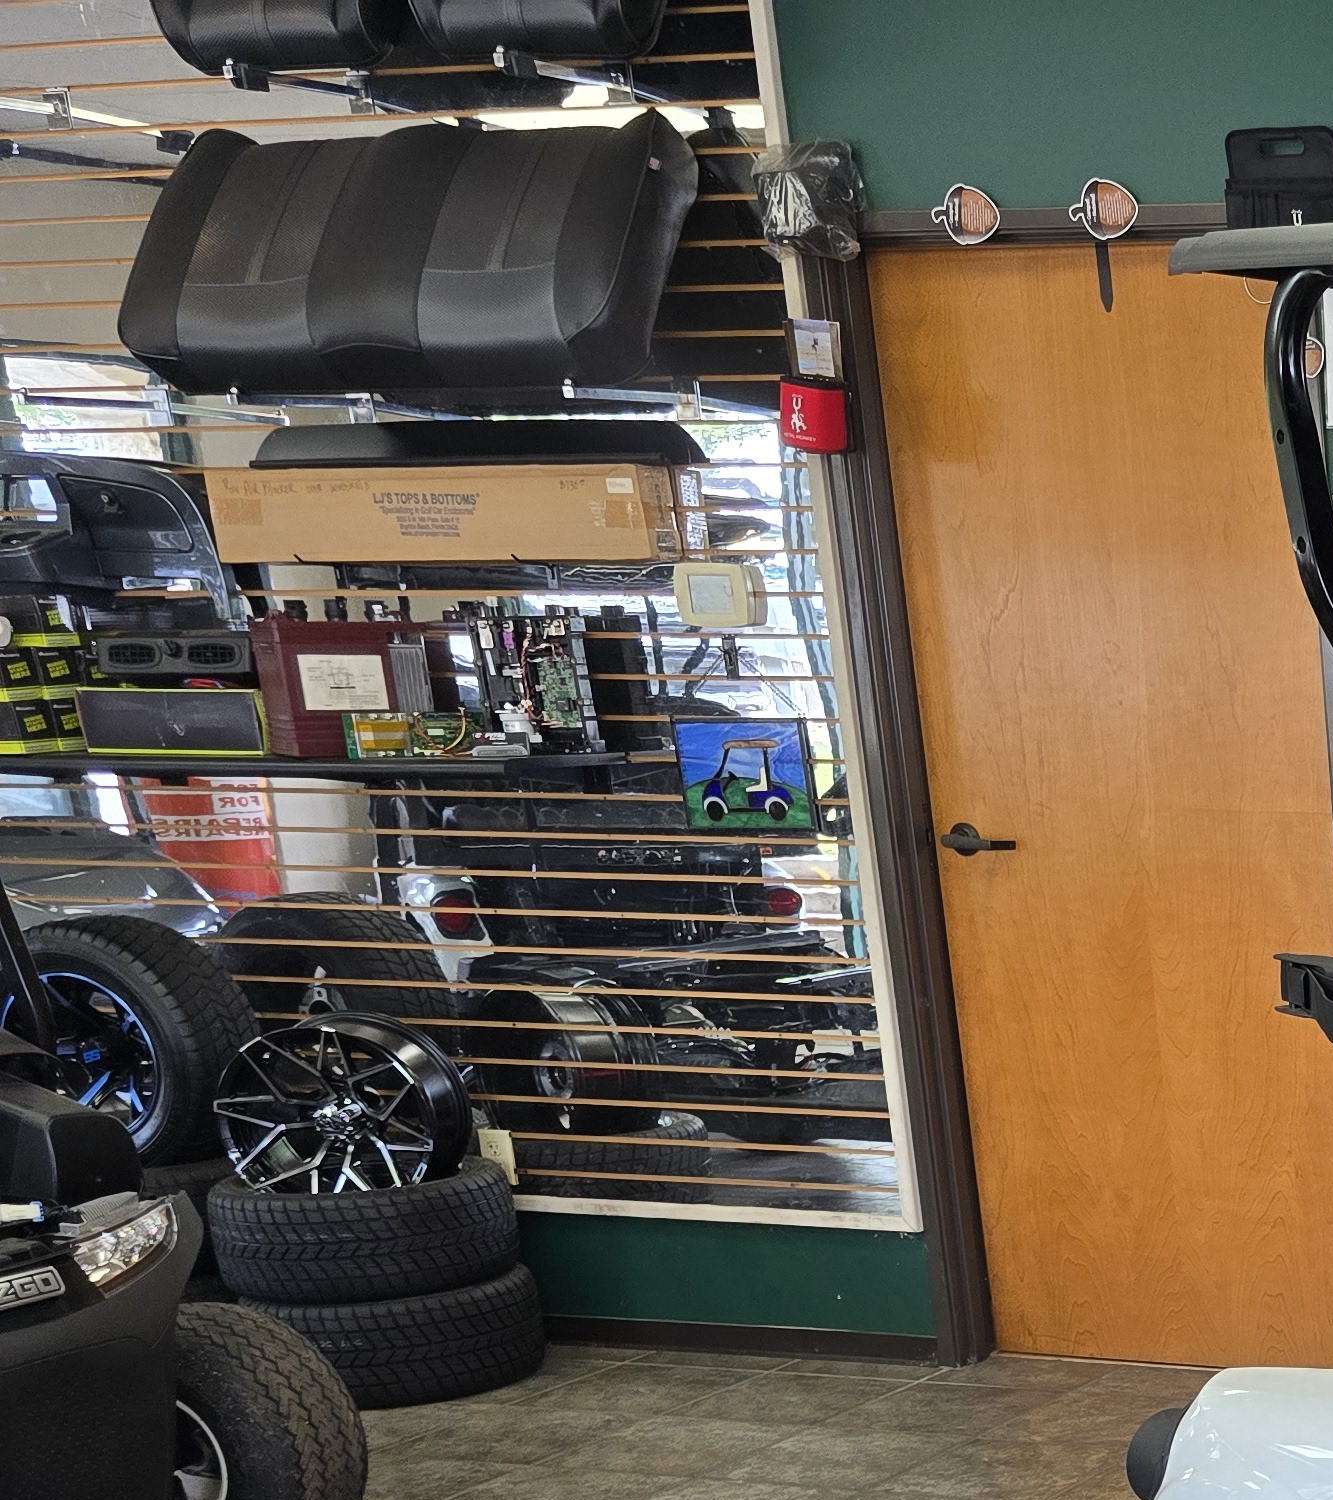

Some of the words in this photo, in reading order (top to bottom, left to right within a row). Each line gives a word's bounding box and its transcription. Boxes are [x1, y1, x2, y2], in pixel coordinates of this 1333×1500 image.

[372, 493, 393, 504] LJ'S
[394, 493, 420, 504] TOPS
[422, 493, 429, 504] &
